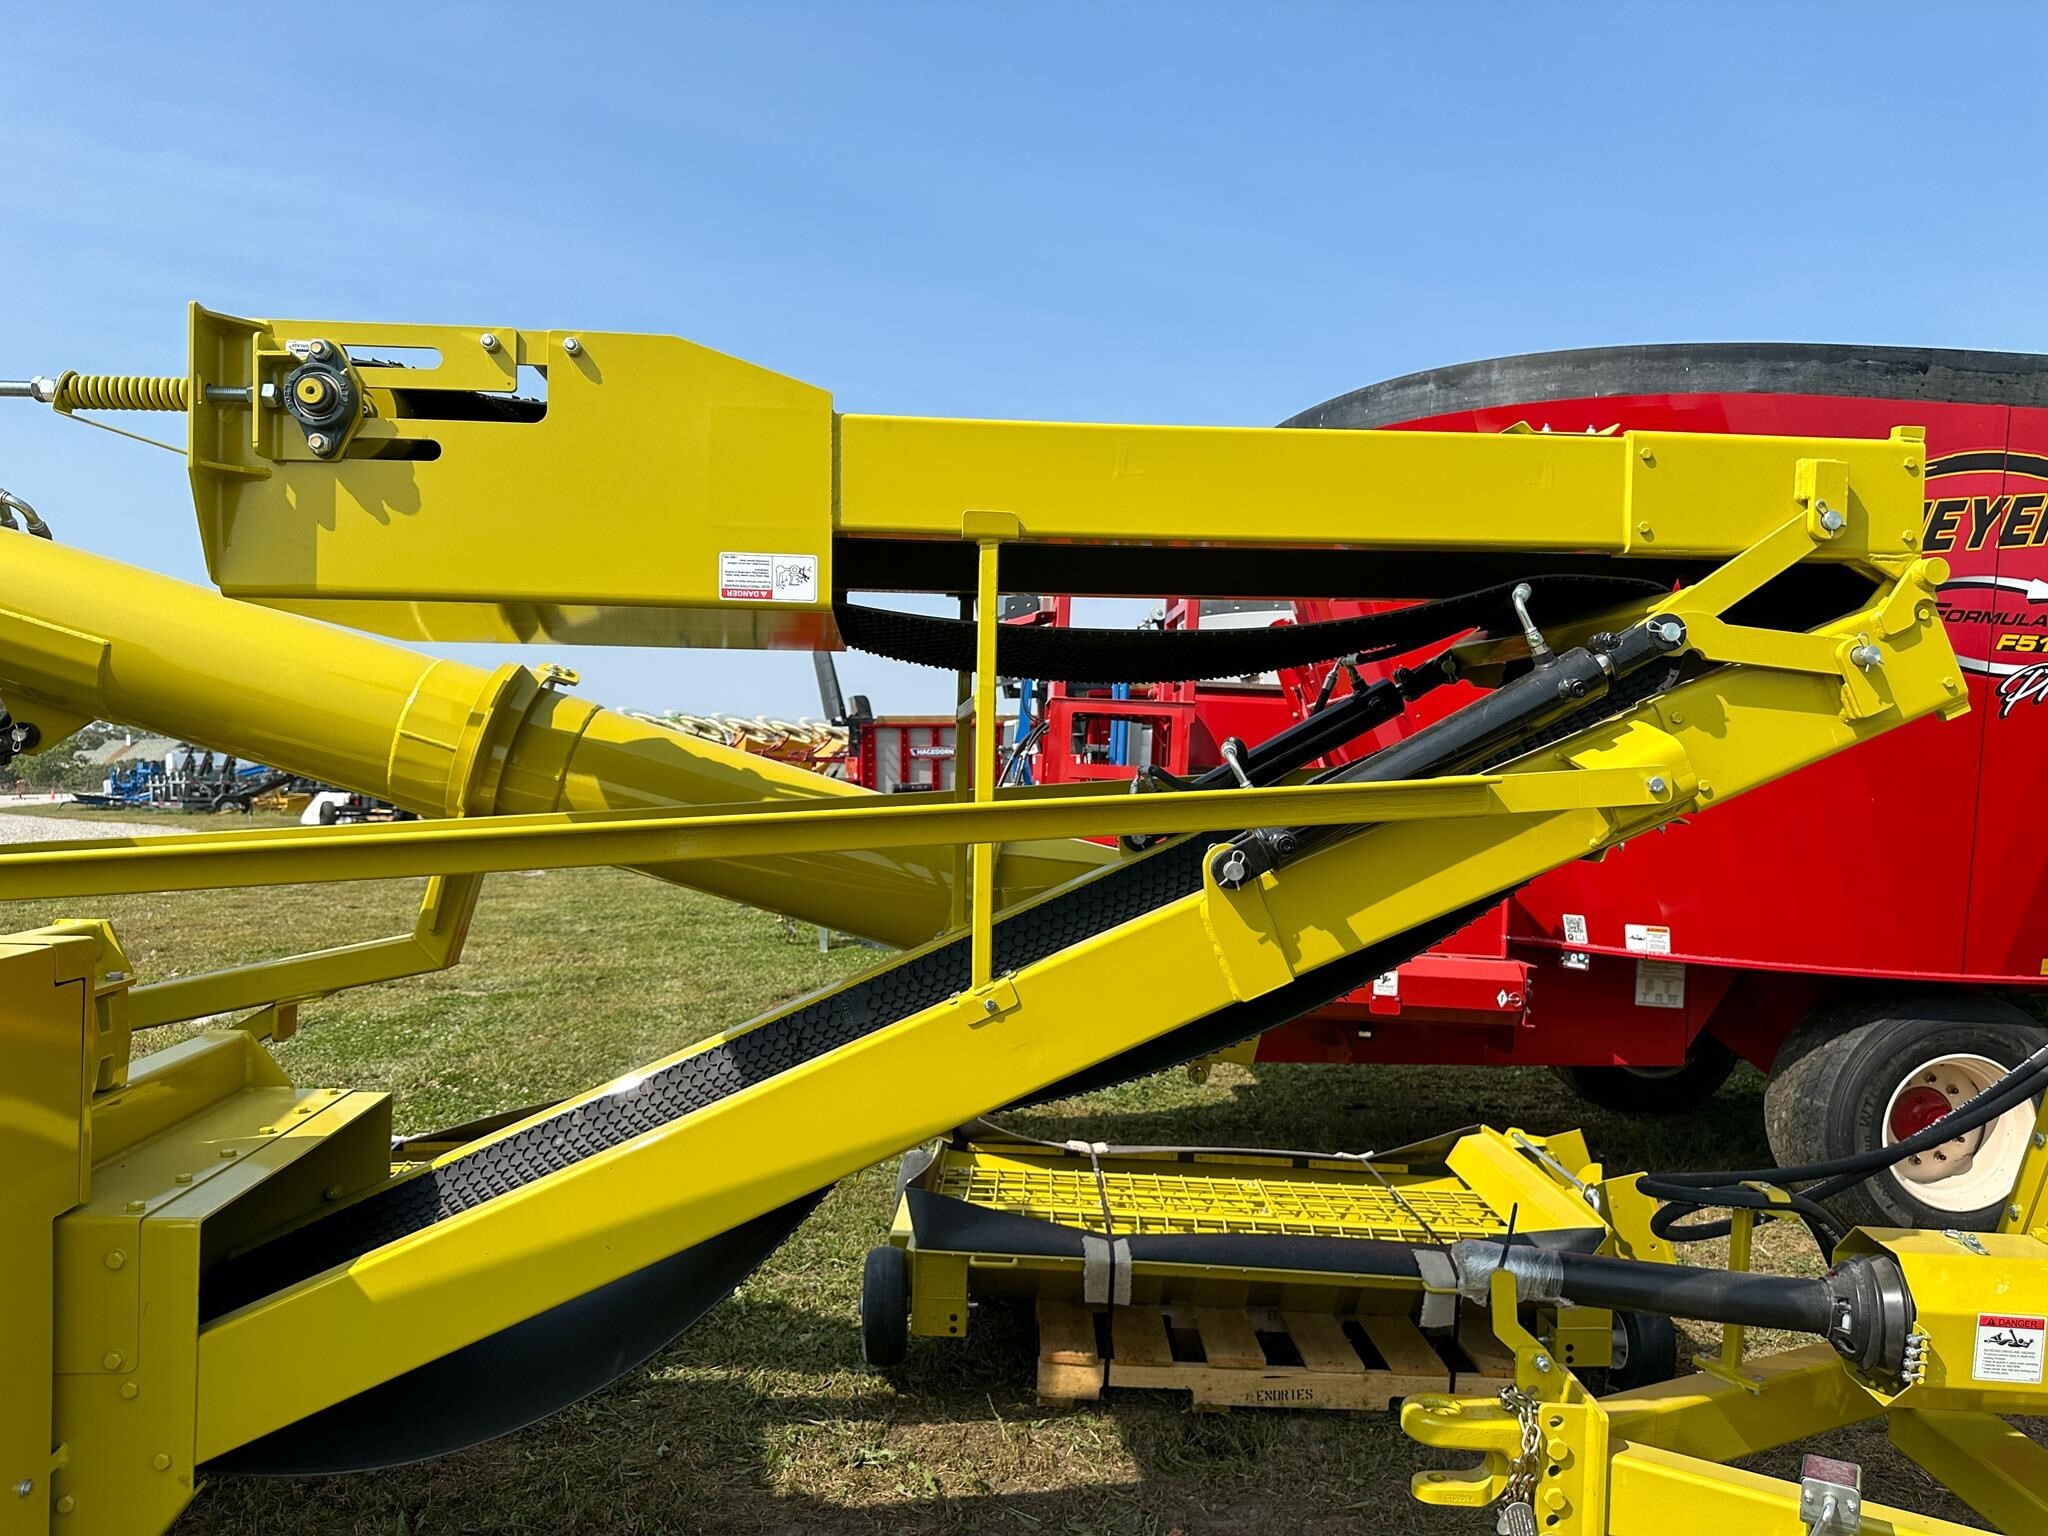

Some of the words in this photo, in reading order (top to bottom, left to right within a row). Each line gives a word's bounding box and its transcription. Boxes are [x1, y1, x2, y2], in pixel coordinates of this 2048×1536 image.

[1921, 493, 2048, 554] EYE
[917, 748, 954, 756] HAGEDORN
[1998, 1318, 2037, 1328] DANGER
[1256, 1388, 1313, 1402] ENDRIES
